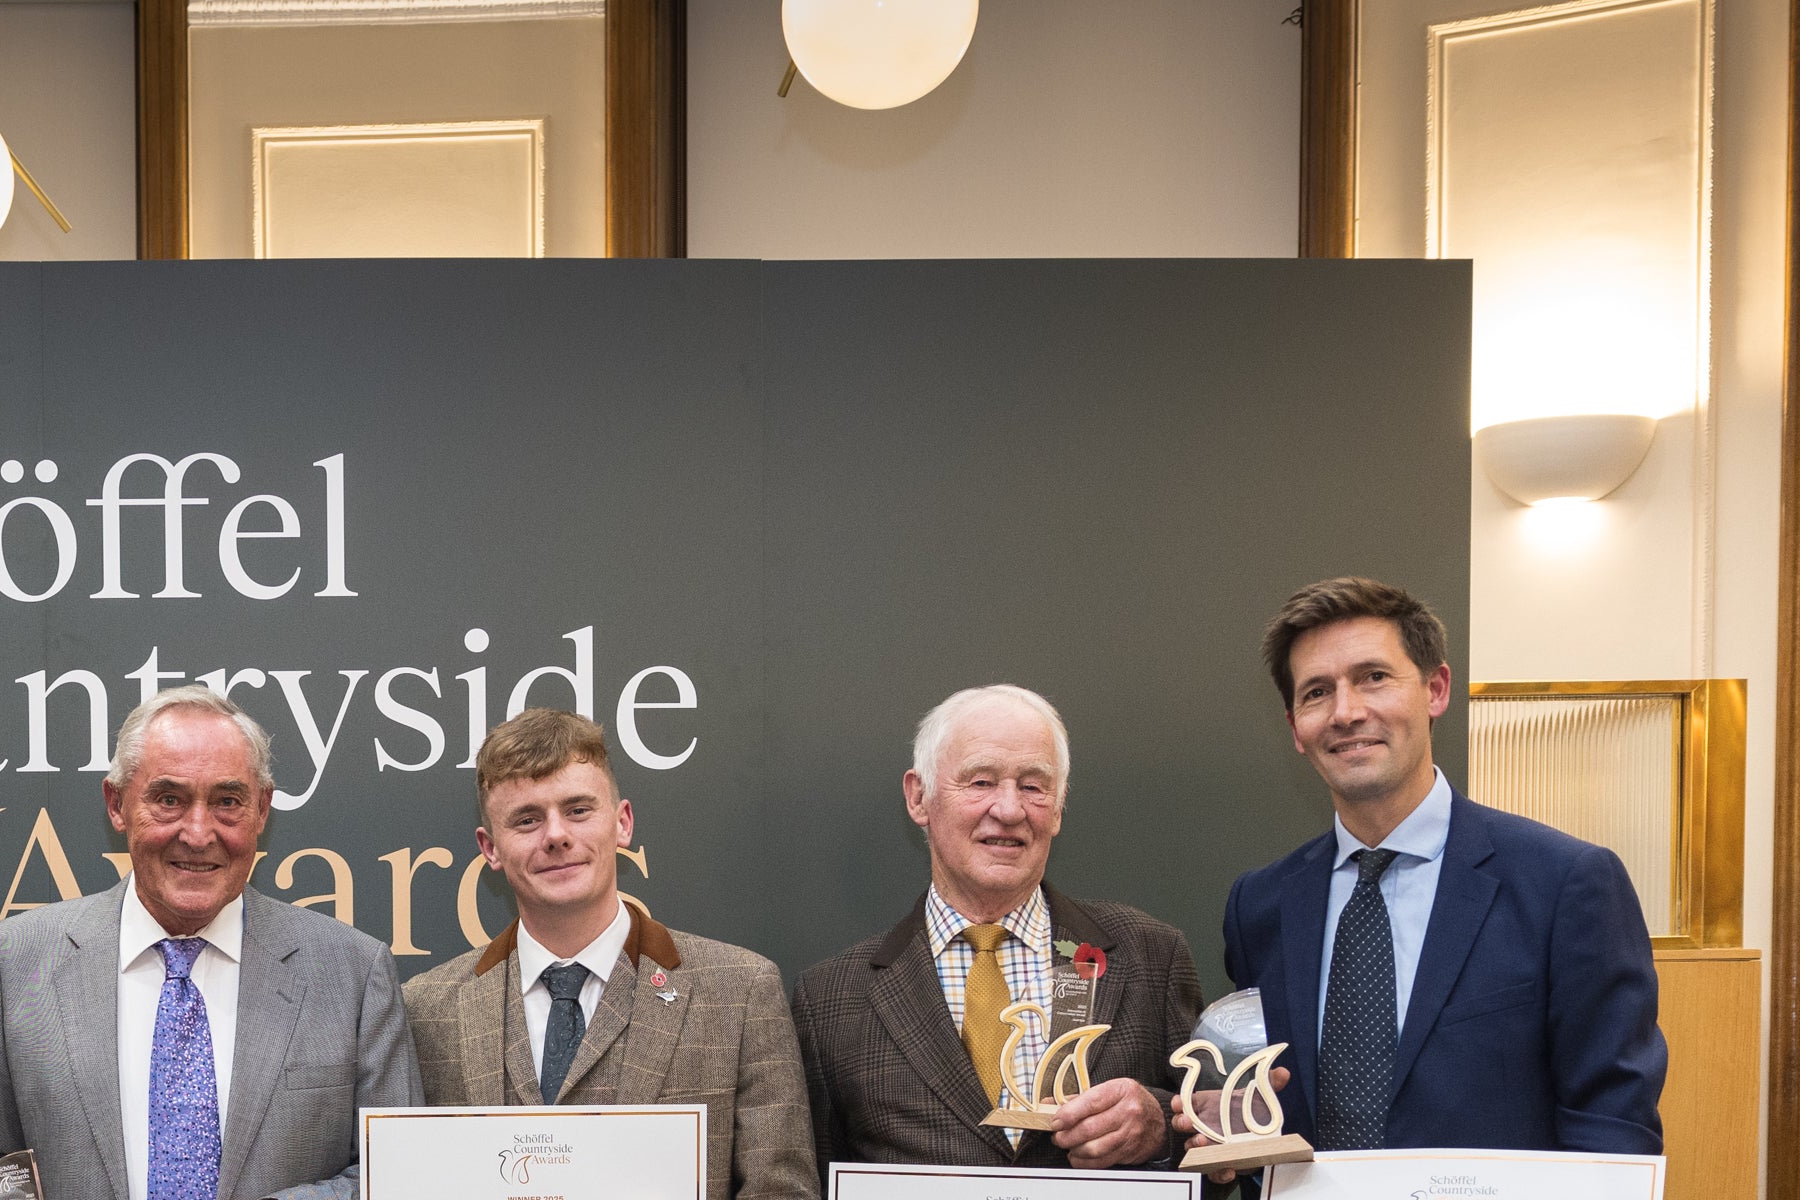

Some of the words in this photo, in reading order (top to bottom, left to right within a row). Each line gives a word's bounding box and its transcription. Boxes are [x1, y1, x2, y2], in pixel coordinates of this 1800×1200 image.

[513, 1133, 554, 1144] Schöffel
[513, 1143, 574, 1156] Countryside
[531, 1154, 571, 1165] Awards
[1429, 1175, 1477, 1186] Schöffel
[1428, 1184, 1499, 1196] Countryside
